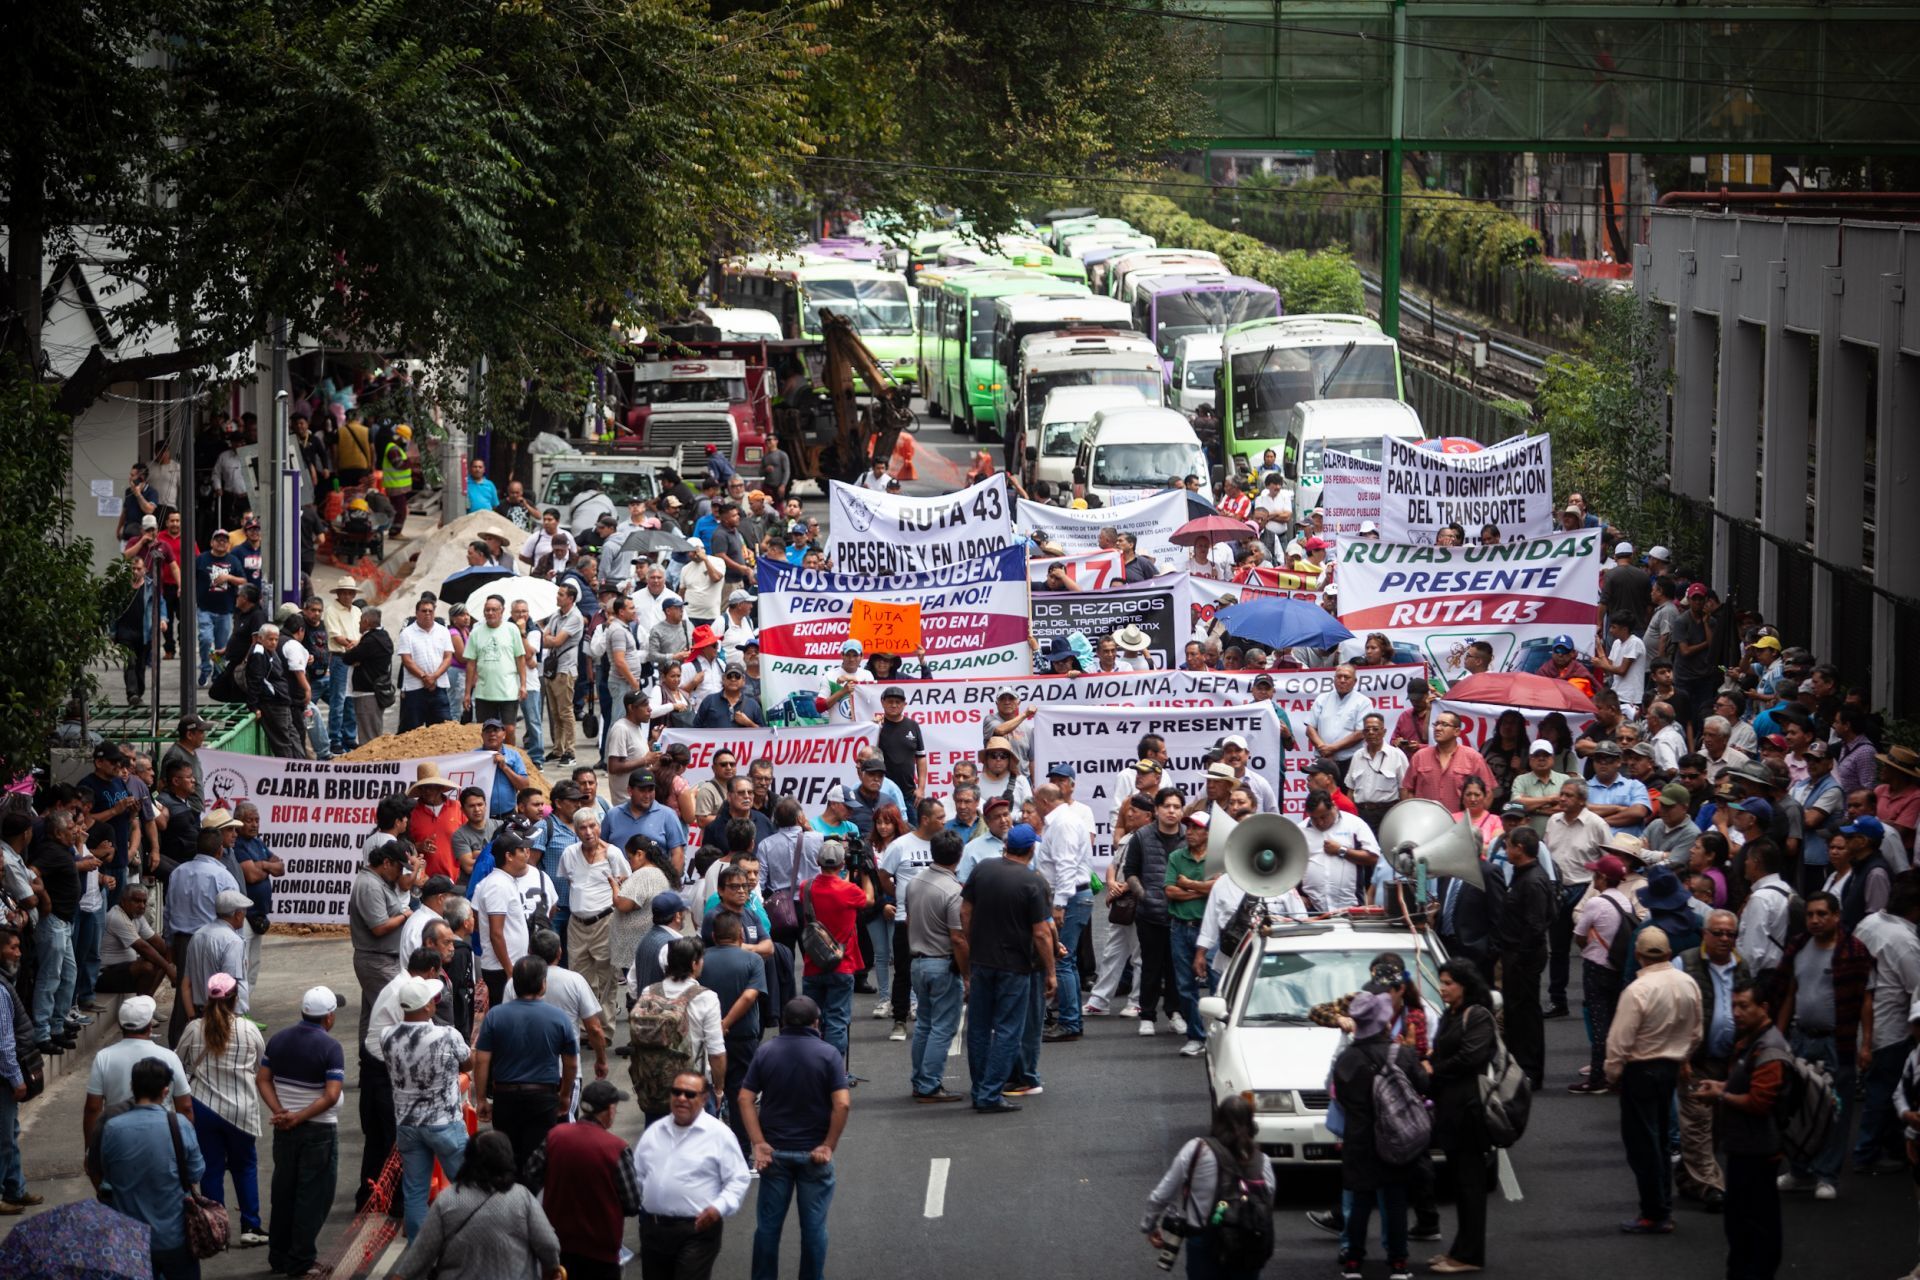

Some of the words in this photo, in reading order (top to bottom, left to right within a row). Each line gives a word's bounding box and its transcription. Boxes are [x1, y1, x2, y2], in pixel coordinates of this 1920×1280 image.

[1324, 453, 1347, 469] CLARA
[1391, 441, 1416, 467] POR
[1421, 451, 1448, 472] UNA
[1452, 455, 1498, 473] TARIFA
[1502, 442, 1543, 470] JUSTA
[1388, 470, 1421, 495] PARA
[1426, 473, 1441, 497] LA
[1446, 469, 1546, 497] DIGNIFICACION
[899, 500, 966, 532] RUTA
[973, 488, 1001, 521] 43
[1333, 508, 1355, 517] SERVICIO
[1408, 499, 1433, 523] DEL
[1437, 499, 1526, 525] TRANSPORTE
[837, 541, 917, 573] PRESENTE
[917, 544, 927, 571] Y
[933, 543, 952, 568] EN
[1343, 541, 1453, 564] RUTAS
[1463, 535, 1597, 562] UNIDAS
[834, 573, 918, 592] COSTOS
[1379, 566, 1562, 592] PRESENTE
[790, 597, 843, 613] PERO
[950, 586, 992, 607] NO!!
[1035, 604, 1062, 618] DE
[1070, 599, 1164, 616] REZAGOS
[949, 616, 968, 629] EN
[970, 614, 989, 628] LA
[1050, 619, 1070, 627] DEL
[1073, 614, 1142, 626] TRANSPORTE
[1388, 600, 1482, 627] RUTA
[1492, 600, 1545, 623] 43
[872, 623, 894, 636] 73
[1094, 625, 1109, 633] DE
[863, 639, 910, 650] APOYA
[925, 636, 933, 647] Y
[938, 634, 985, 648] DIGNA!
[772, 662, 817, 676] PARA
[964, 683, 1077, 704] BRGADA
[1085, 677, 1178, 698] MOLINA,
[1185, 677, 1239, 693] JEFA
[1053, 721, 1109, 737] RUTA
[1116, 720, 1141, 734] 47
[1149, 717, 1262, 733] PRESENTE
[761, 735, 870, 765] AUMENTO
[256, 778, 319, 799] CLARA
[1092, 785, 1106, 799] A
[271, 805, 308, 823] RUTA
[312, 807, 322, 823] 4
[324, 807, 378, 824] PRESEN
[309, 833, 352, 850] DIGNO,
[287, 859, 352, 874] GOBIERNO
[272, 879, 351, 894] HOMOLOGAR
[277, 900, 325, 914] ESTADO
[328, 901, 345, 914] DE
